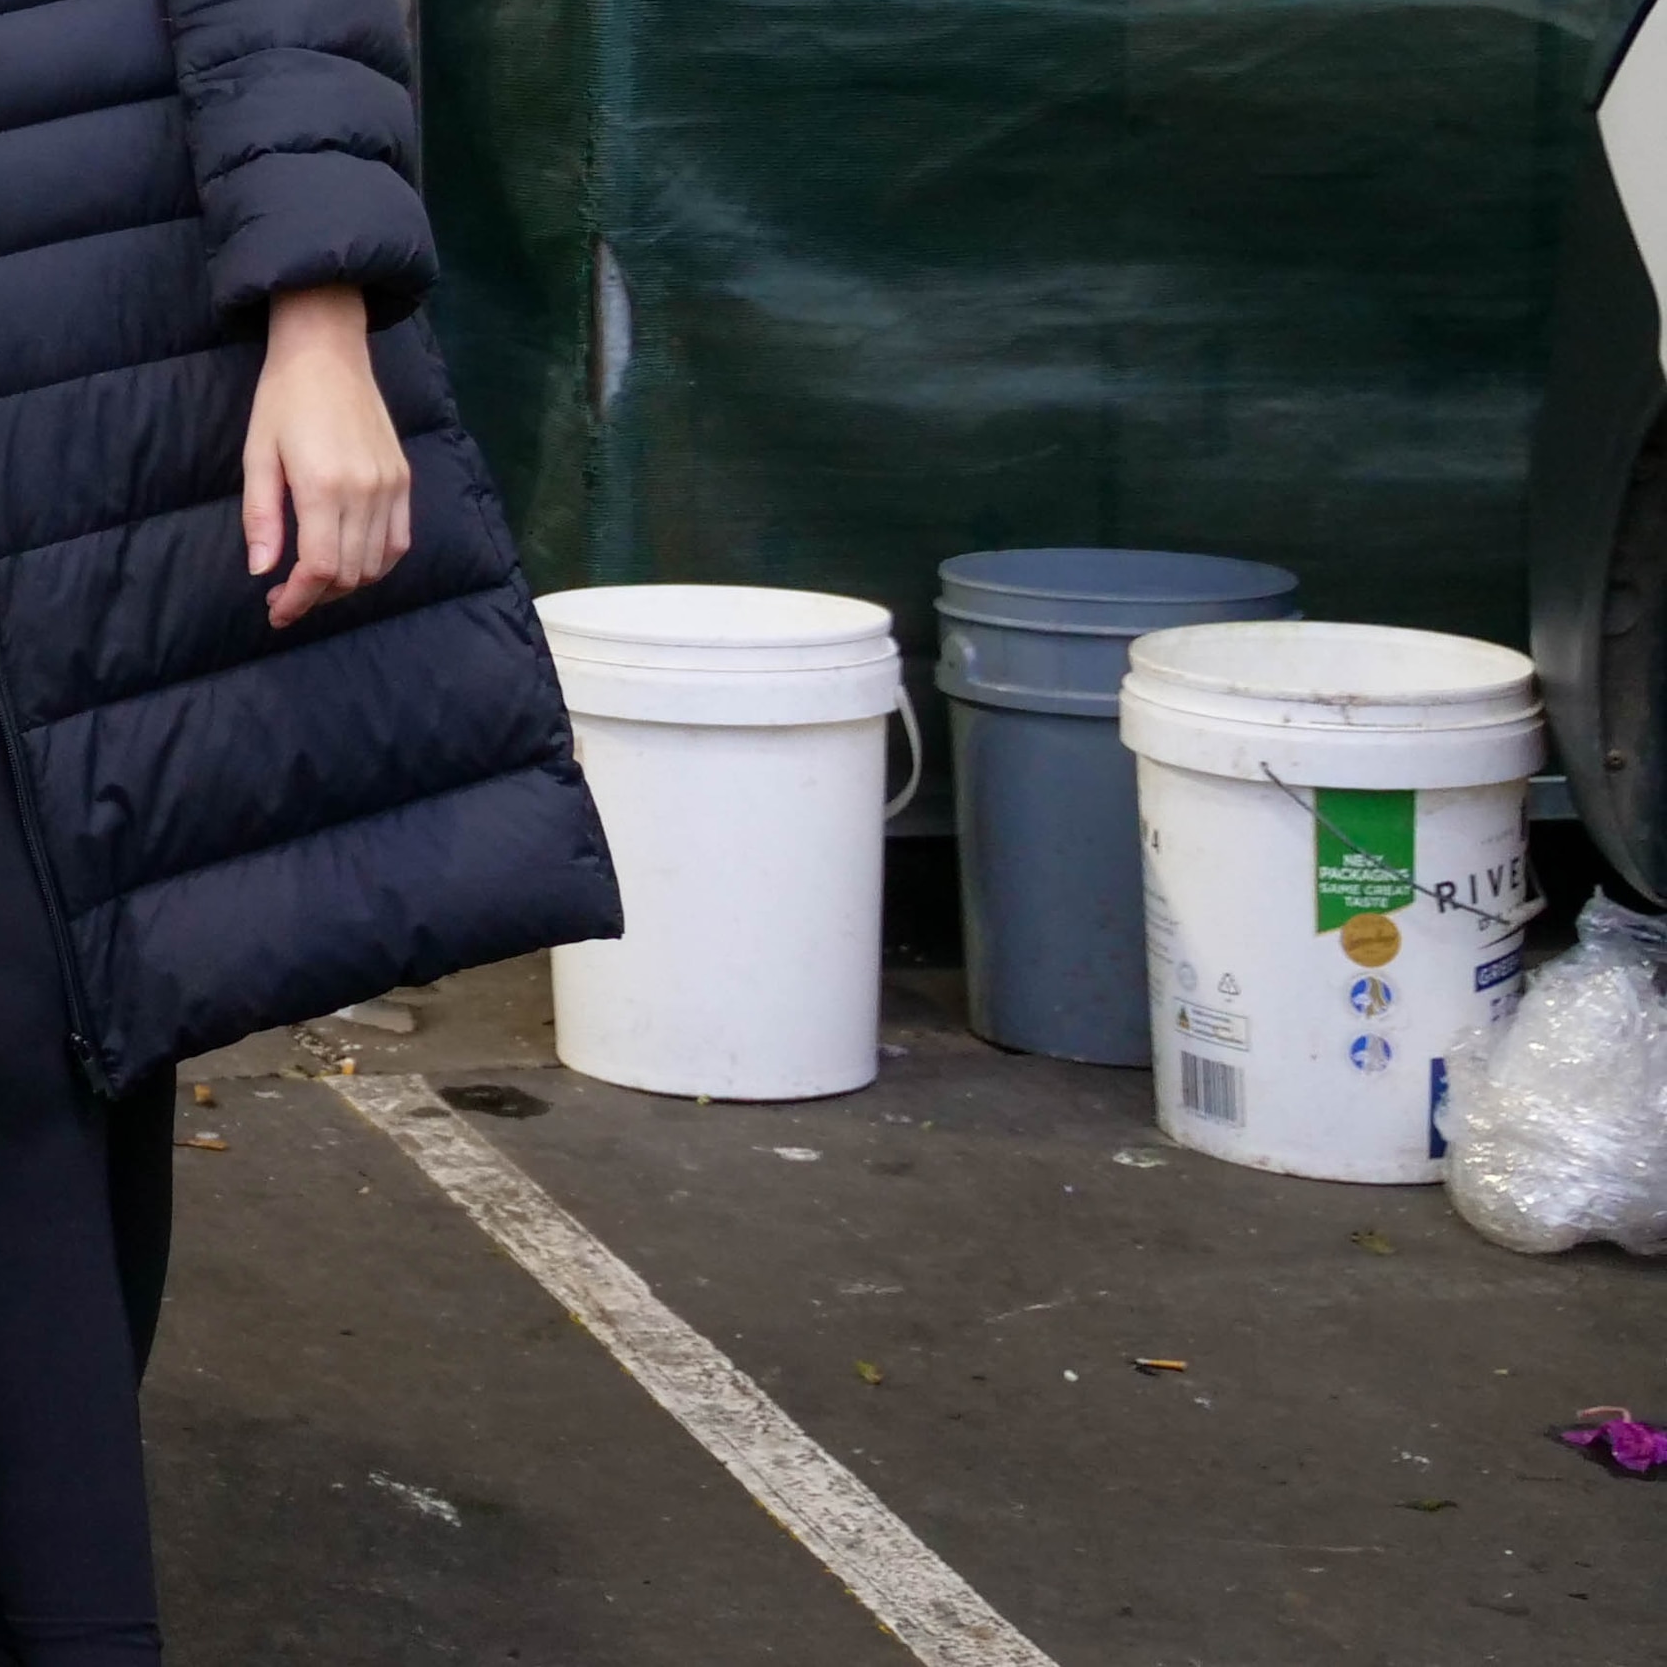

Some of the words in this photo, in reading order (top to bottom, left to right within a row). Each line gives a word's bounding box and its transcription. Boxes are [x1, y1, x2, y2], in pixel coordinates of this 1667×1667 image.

[1342, 853, 1384, 867] NEW
[1318, 866, 1410, 881] PACKAGING
[1320, 883, 1361, 895] SAME
[1363, 884, 1412, 896] GREAT
[1435, 857, 1521, 914] RIVE
[1344, 896, 1389, 908] TASTE
